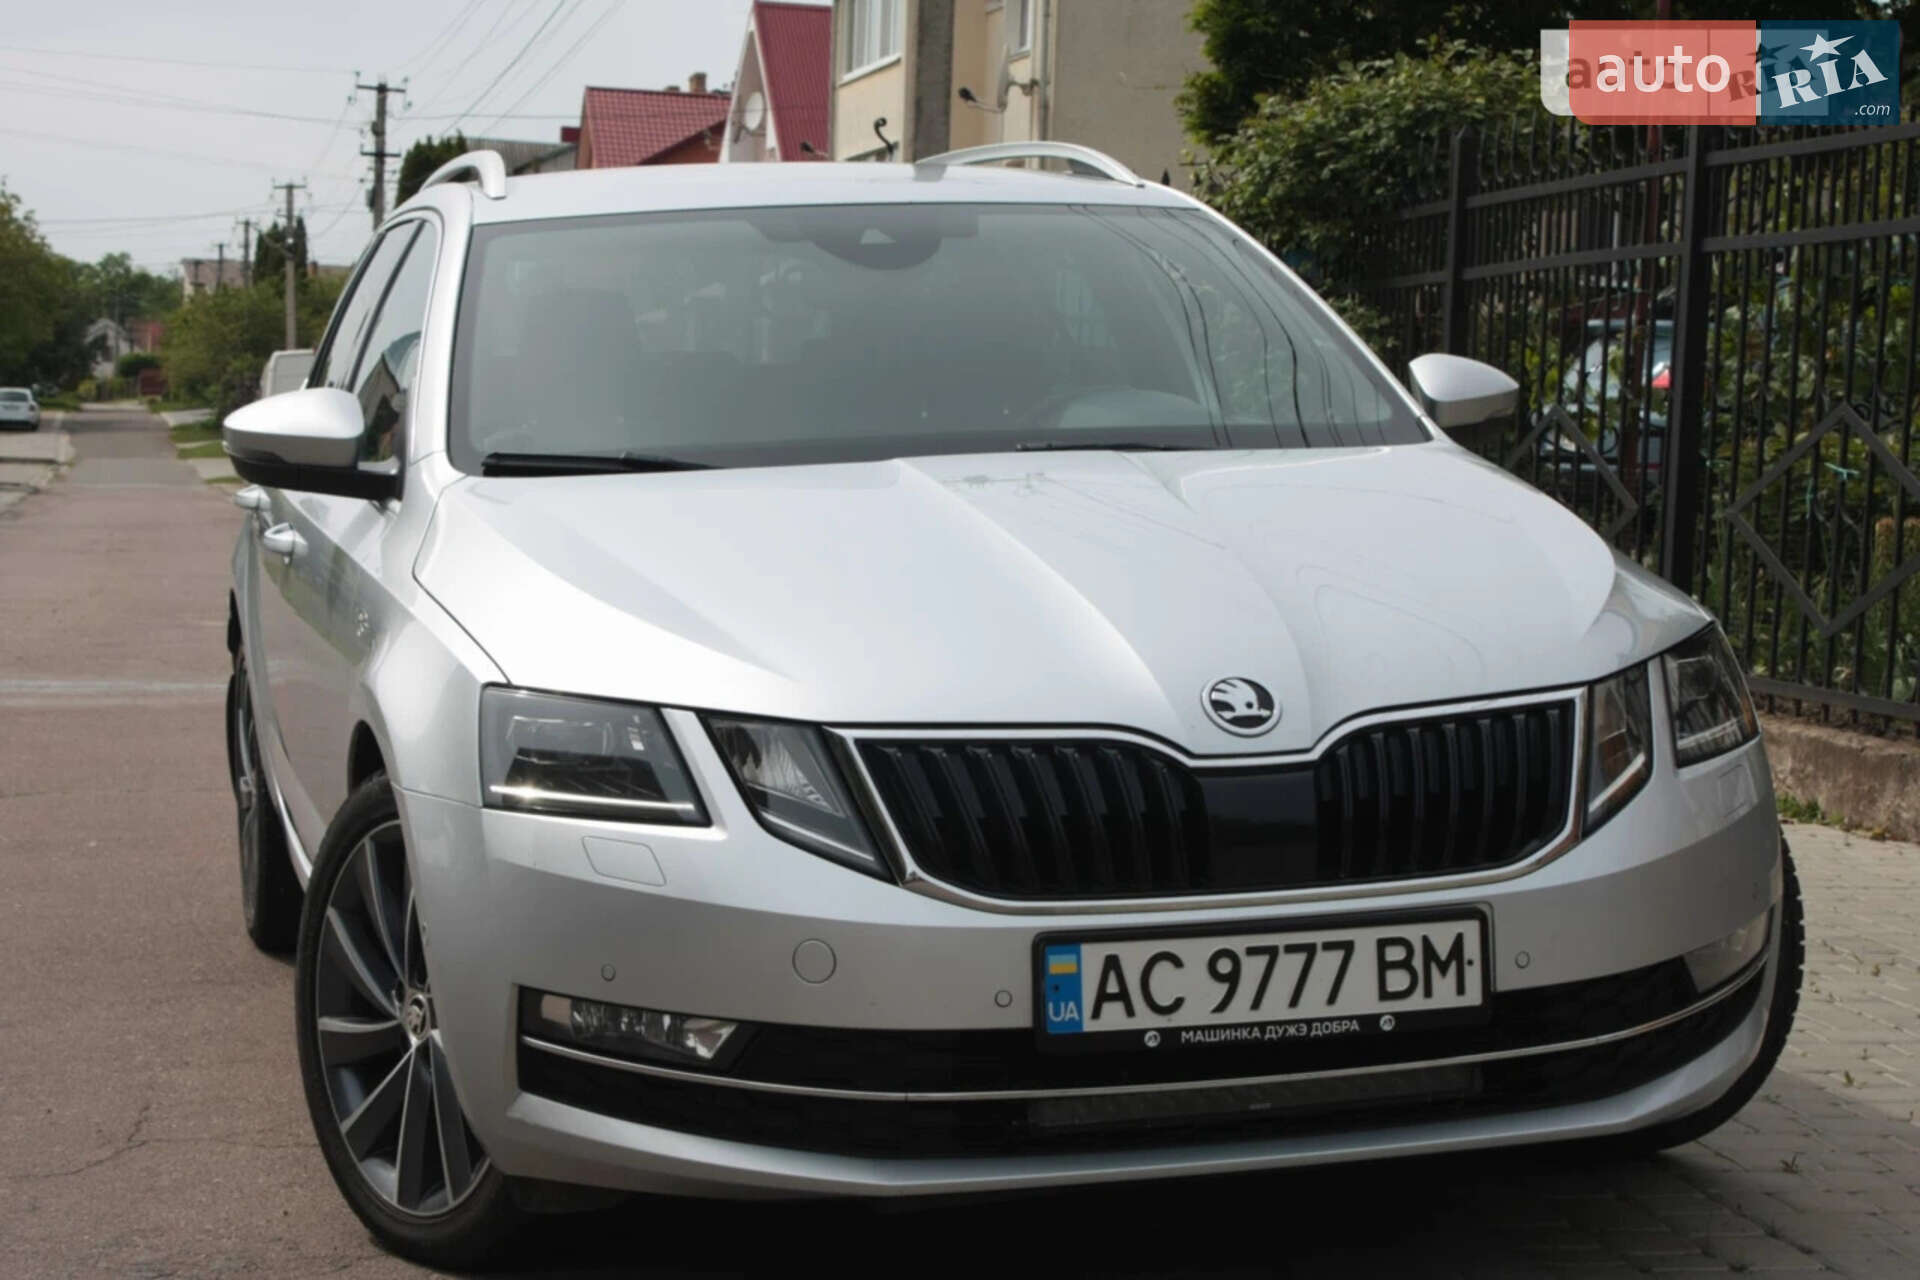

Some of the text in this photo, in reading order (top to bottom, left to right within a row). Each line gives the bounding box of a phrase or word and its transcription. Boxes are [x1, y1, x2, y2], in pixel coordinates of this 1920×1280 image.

[1091, 931, 1465, 1020] AC 9777 BM
[1048, 1001, 1080, 1022] UA
[1180, 1019, 1360, 1043] МАШИНКА ДУЖЭ ДОБРА
